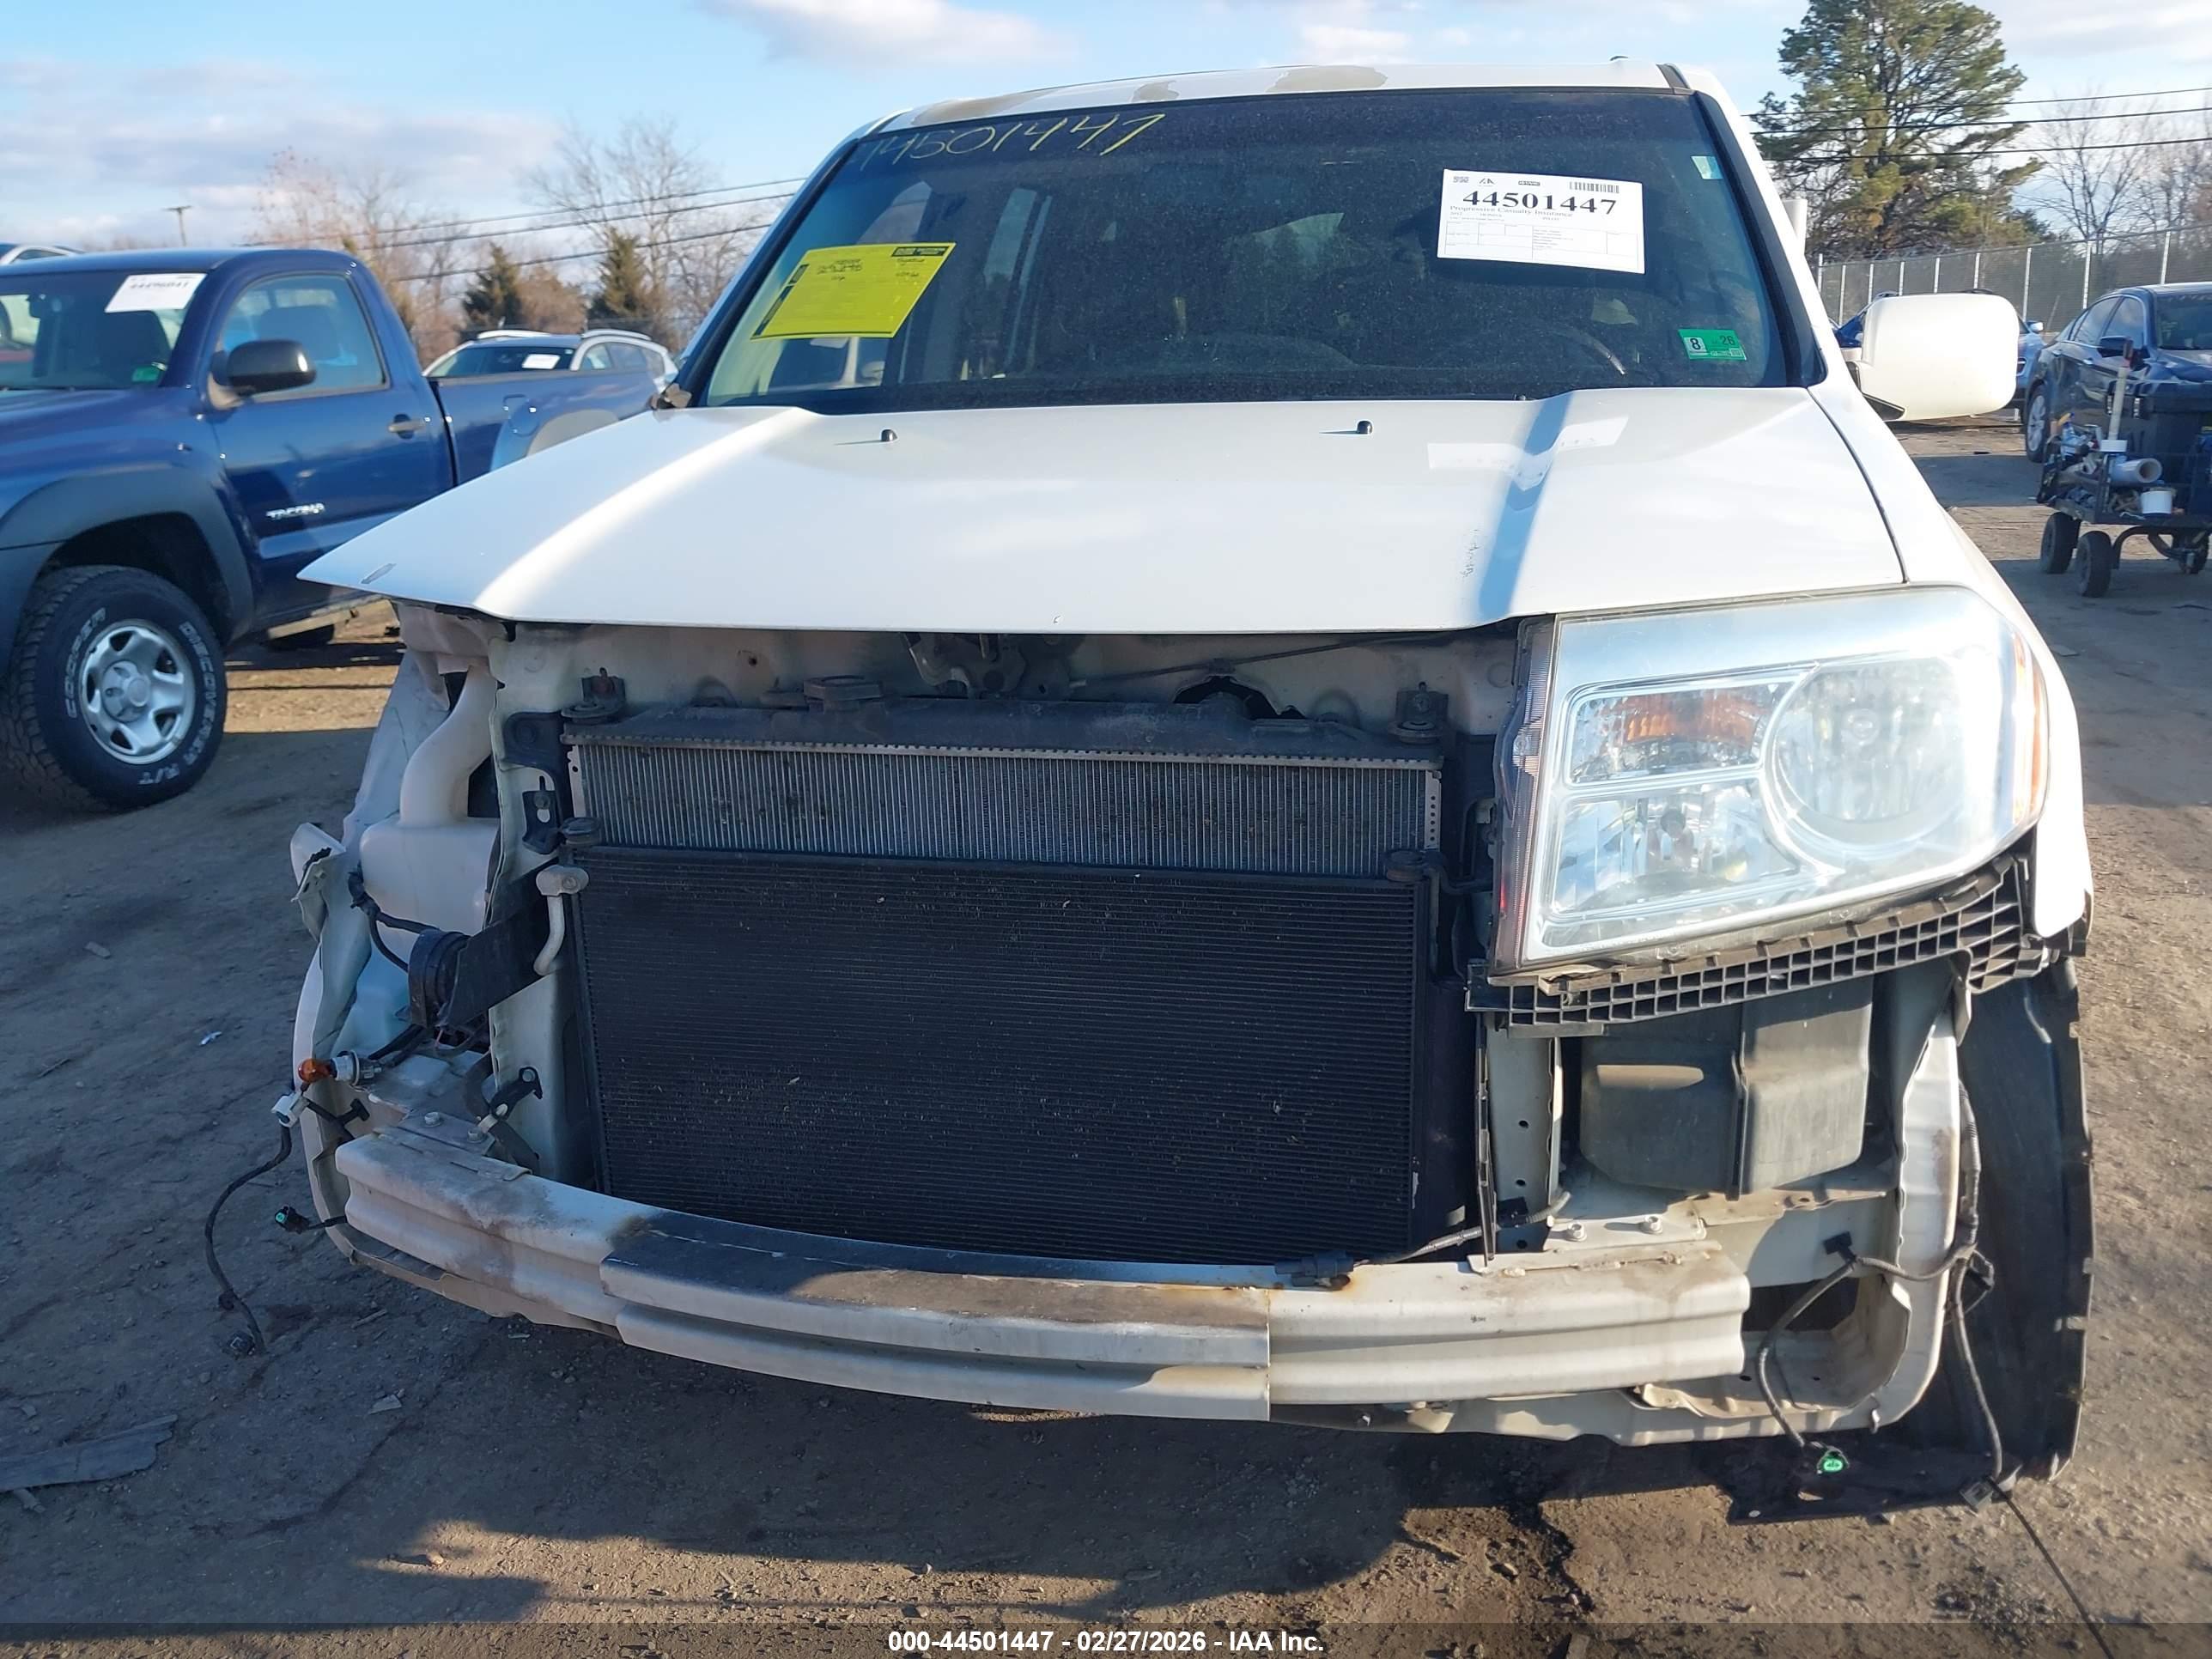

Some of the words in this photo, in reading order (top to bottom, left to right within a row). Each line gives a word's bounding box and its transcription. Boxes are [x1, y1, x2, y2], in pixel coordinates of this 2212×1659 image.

[1462, 190, 1617, 215] 44501447
[1689, 337, 1701, 350] 8
[1719, 335, 1736, 346] 26
